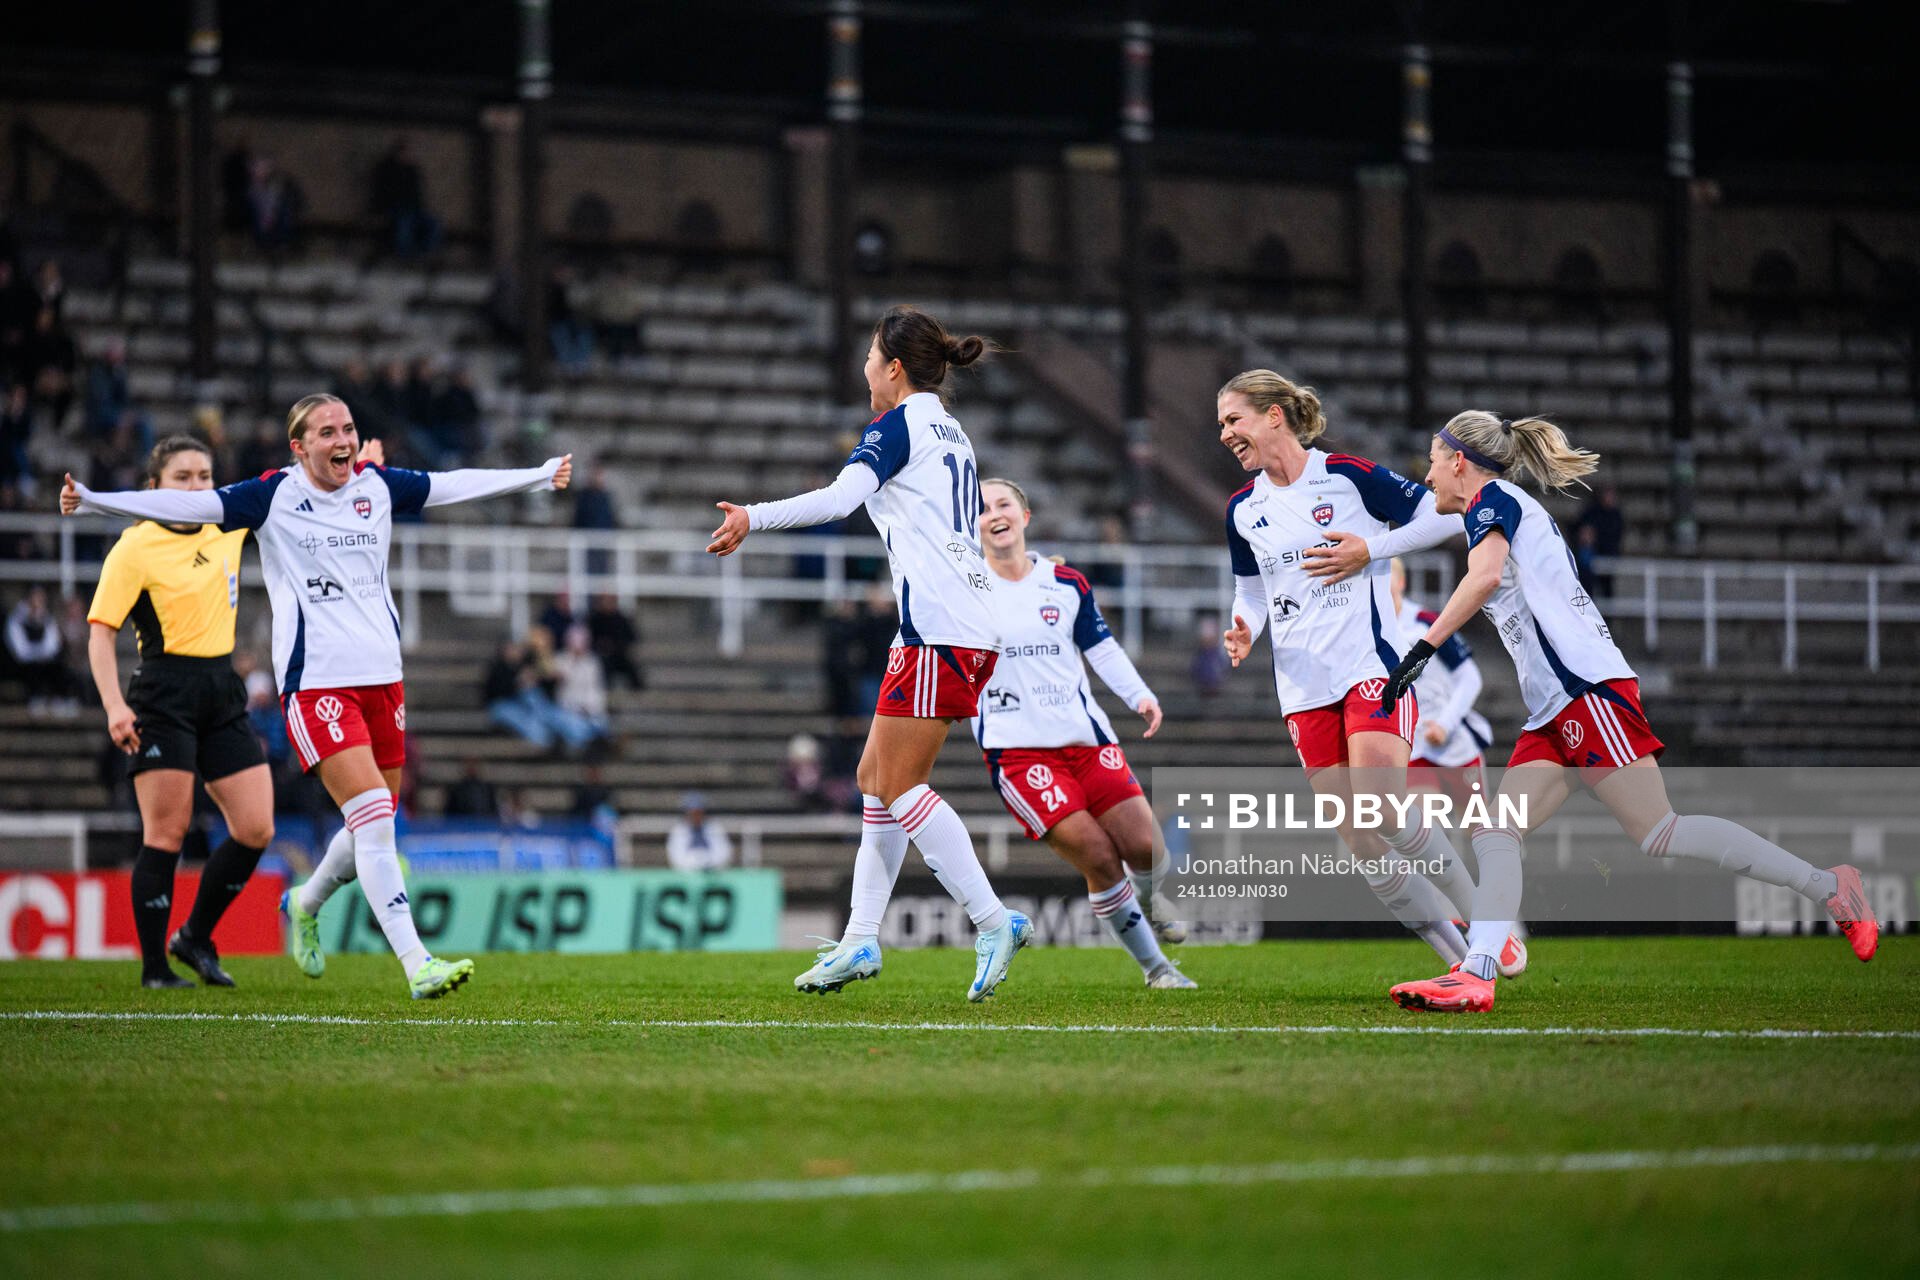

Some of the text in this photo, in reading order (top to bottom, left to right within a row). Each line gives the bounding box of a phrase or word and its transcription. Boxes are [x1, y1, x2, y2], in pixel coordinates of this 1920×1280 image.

[943, 452, 977, 540] 10
[1311, 582, 1353, 599] MELLBY
[327, 720, 344, 743] 6
[1040, 784, 1069, 813] 24
[336, 886, 735, 952] IP ISP ISP
